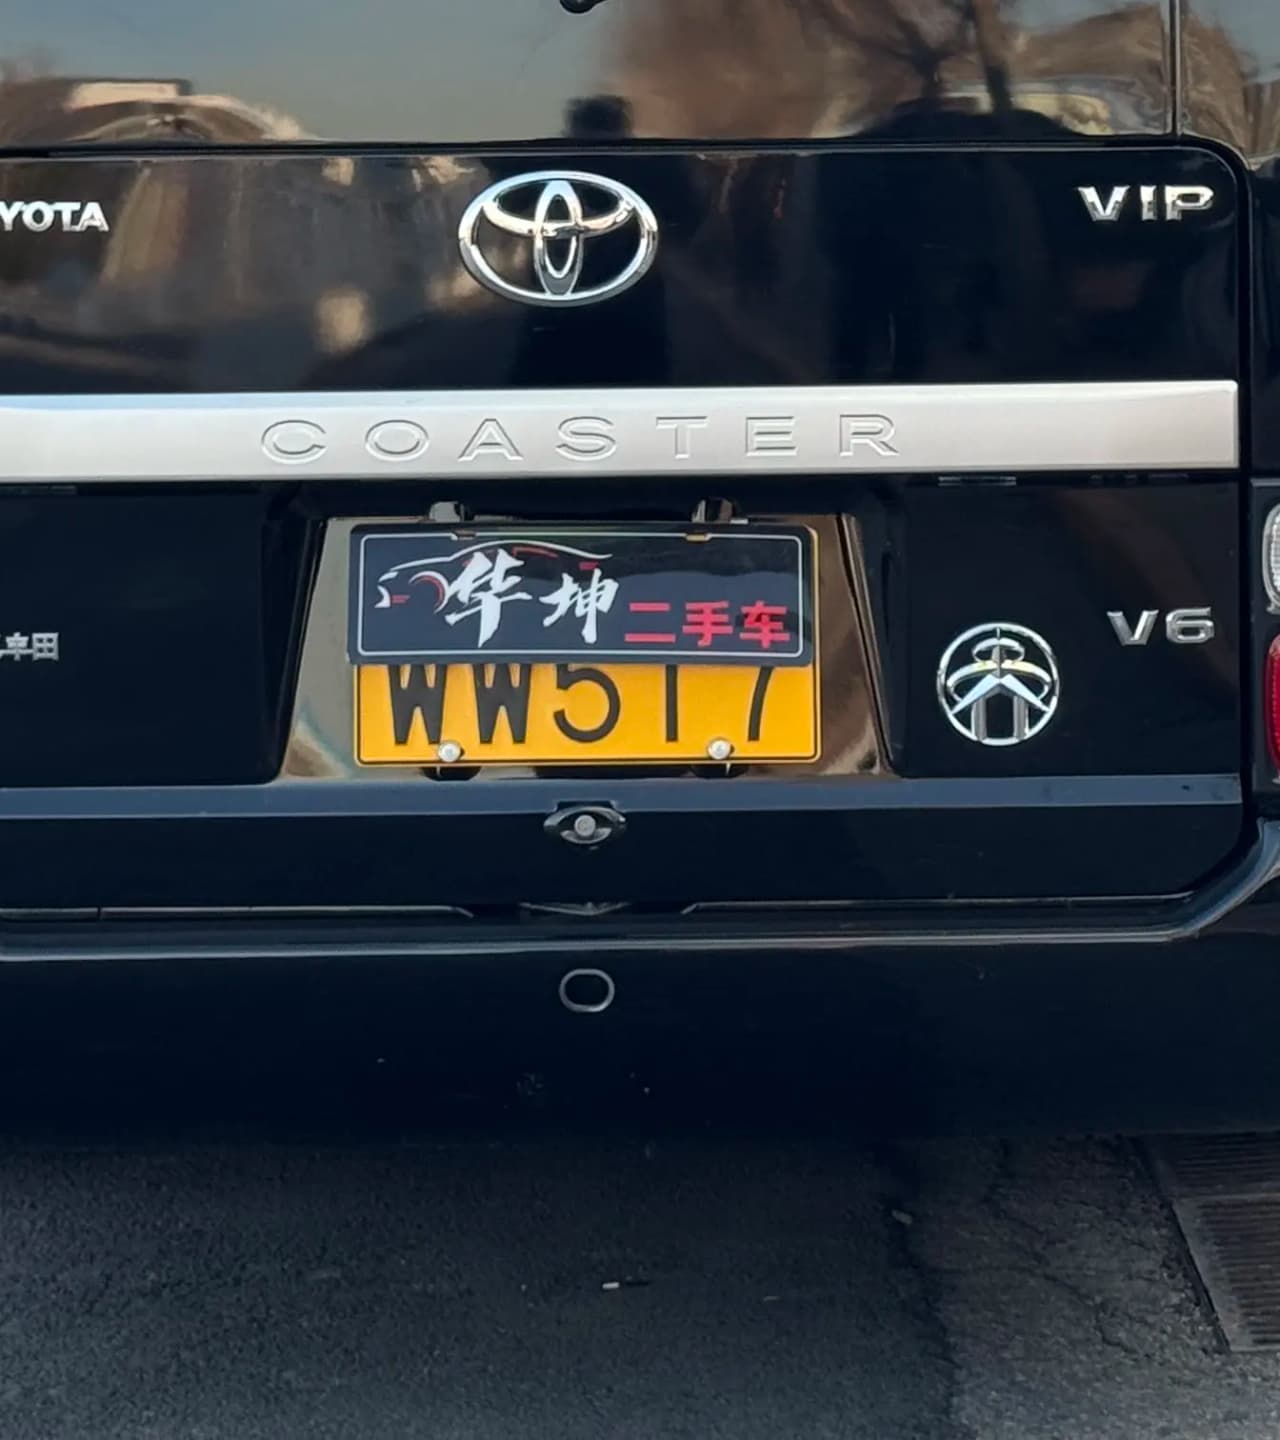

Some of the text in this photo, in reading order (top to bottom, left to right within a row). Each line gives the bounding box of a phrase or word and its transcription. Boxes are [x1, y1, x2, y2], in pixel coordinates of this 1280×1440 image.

[1077, 185, 1214, 222] VIP
[261, 414, 899, 464] COASTER
[445, 549, 791, 648] 华坤 二手车
[1107, 607, 1215, 645] V6
